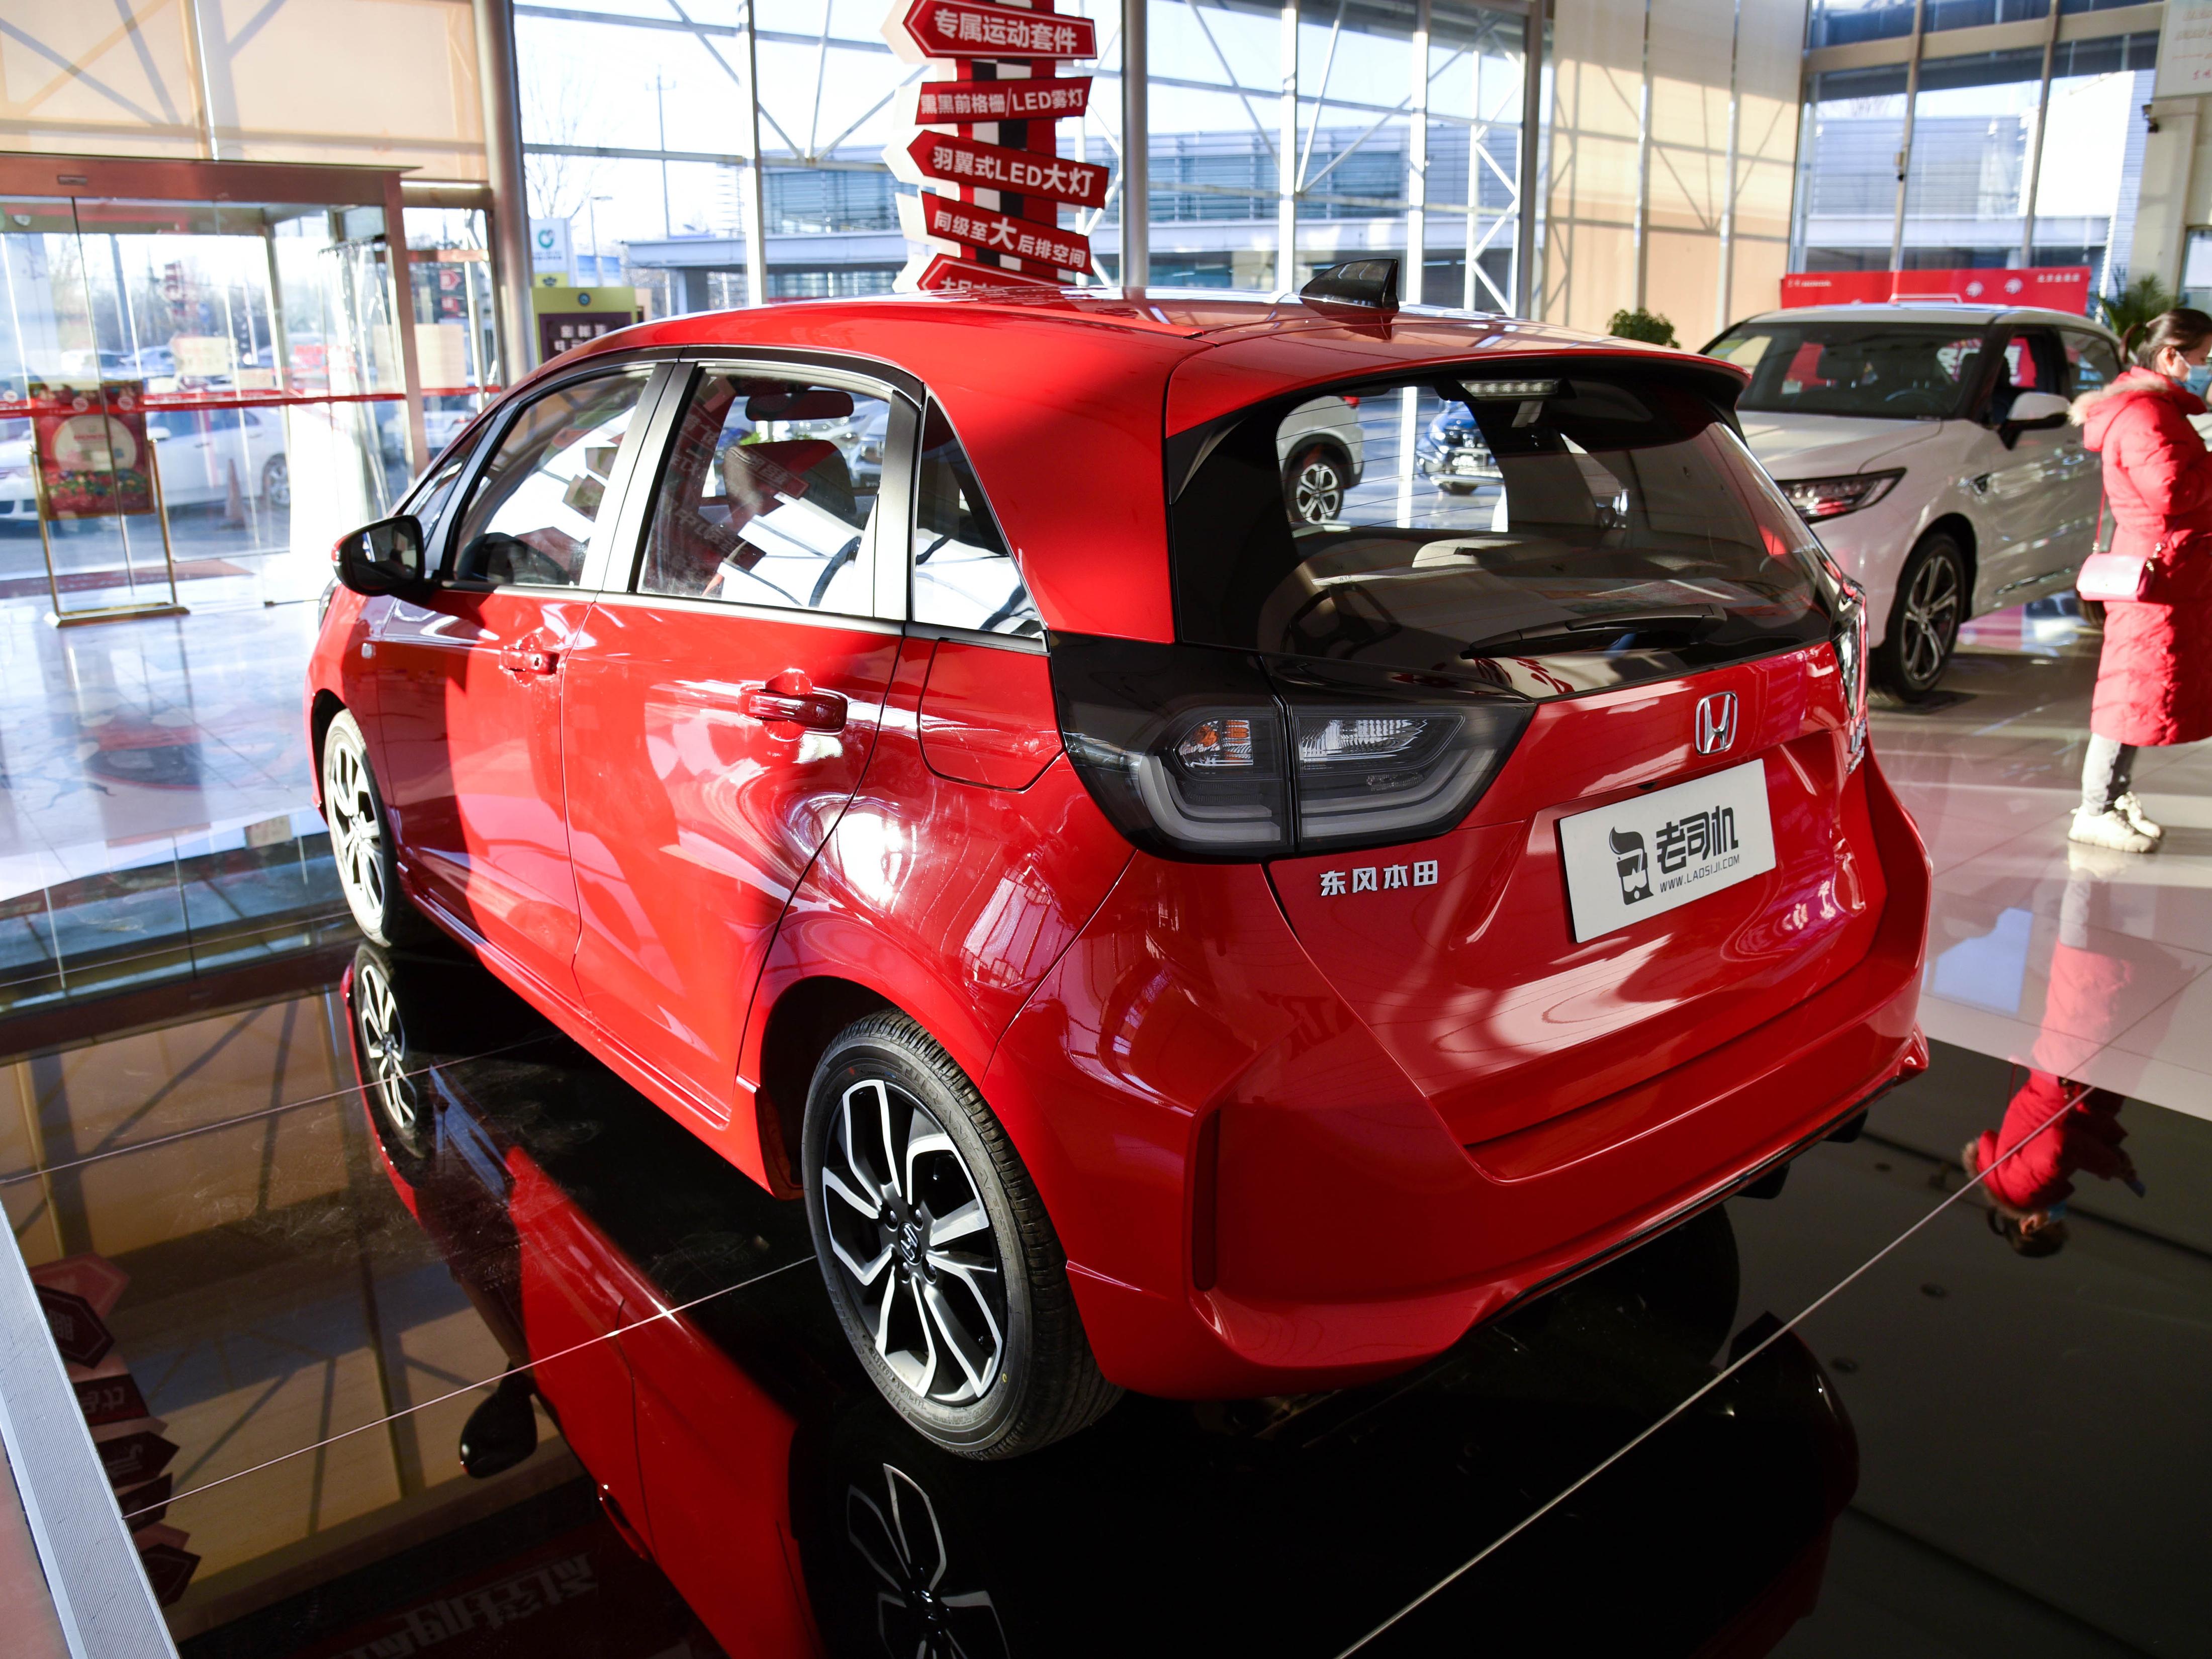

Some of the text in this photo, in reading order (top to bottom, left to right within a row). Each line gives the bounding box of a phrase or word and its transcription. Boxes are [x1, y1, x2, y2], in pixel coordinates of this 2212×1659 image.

[934, 9, 1077, 54] 专属运动套件
[920, 87, 1083, 117] 熏黑前格栅/LED雾灯
[933, 145, 1094, 198] 羽翼式LED大灯
[1655, 805, 1738, 874] 老司机
[1320, 860, 1438, 896] 东风本田
[1660, 854, 1740, 893] WWW.LAOSIJI.COM
